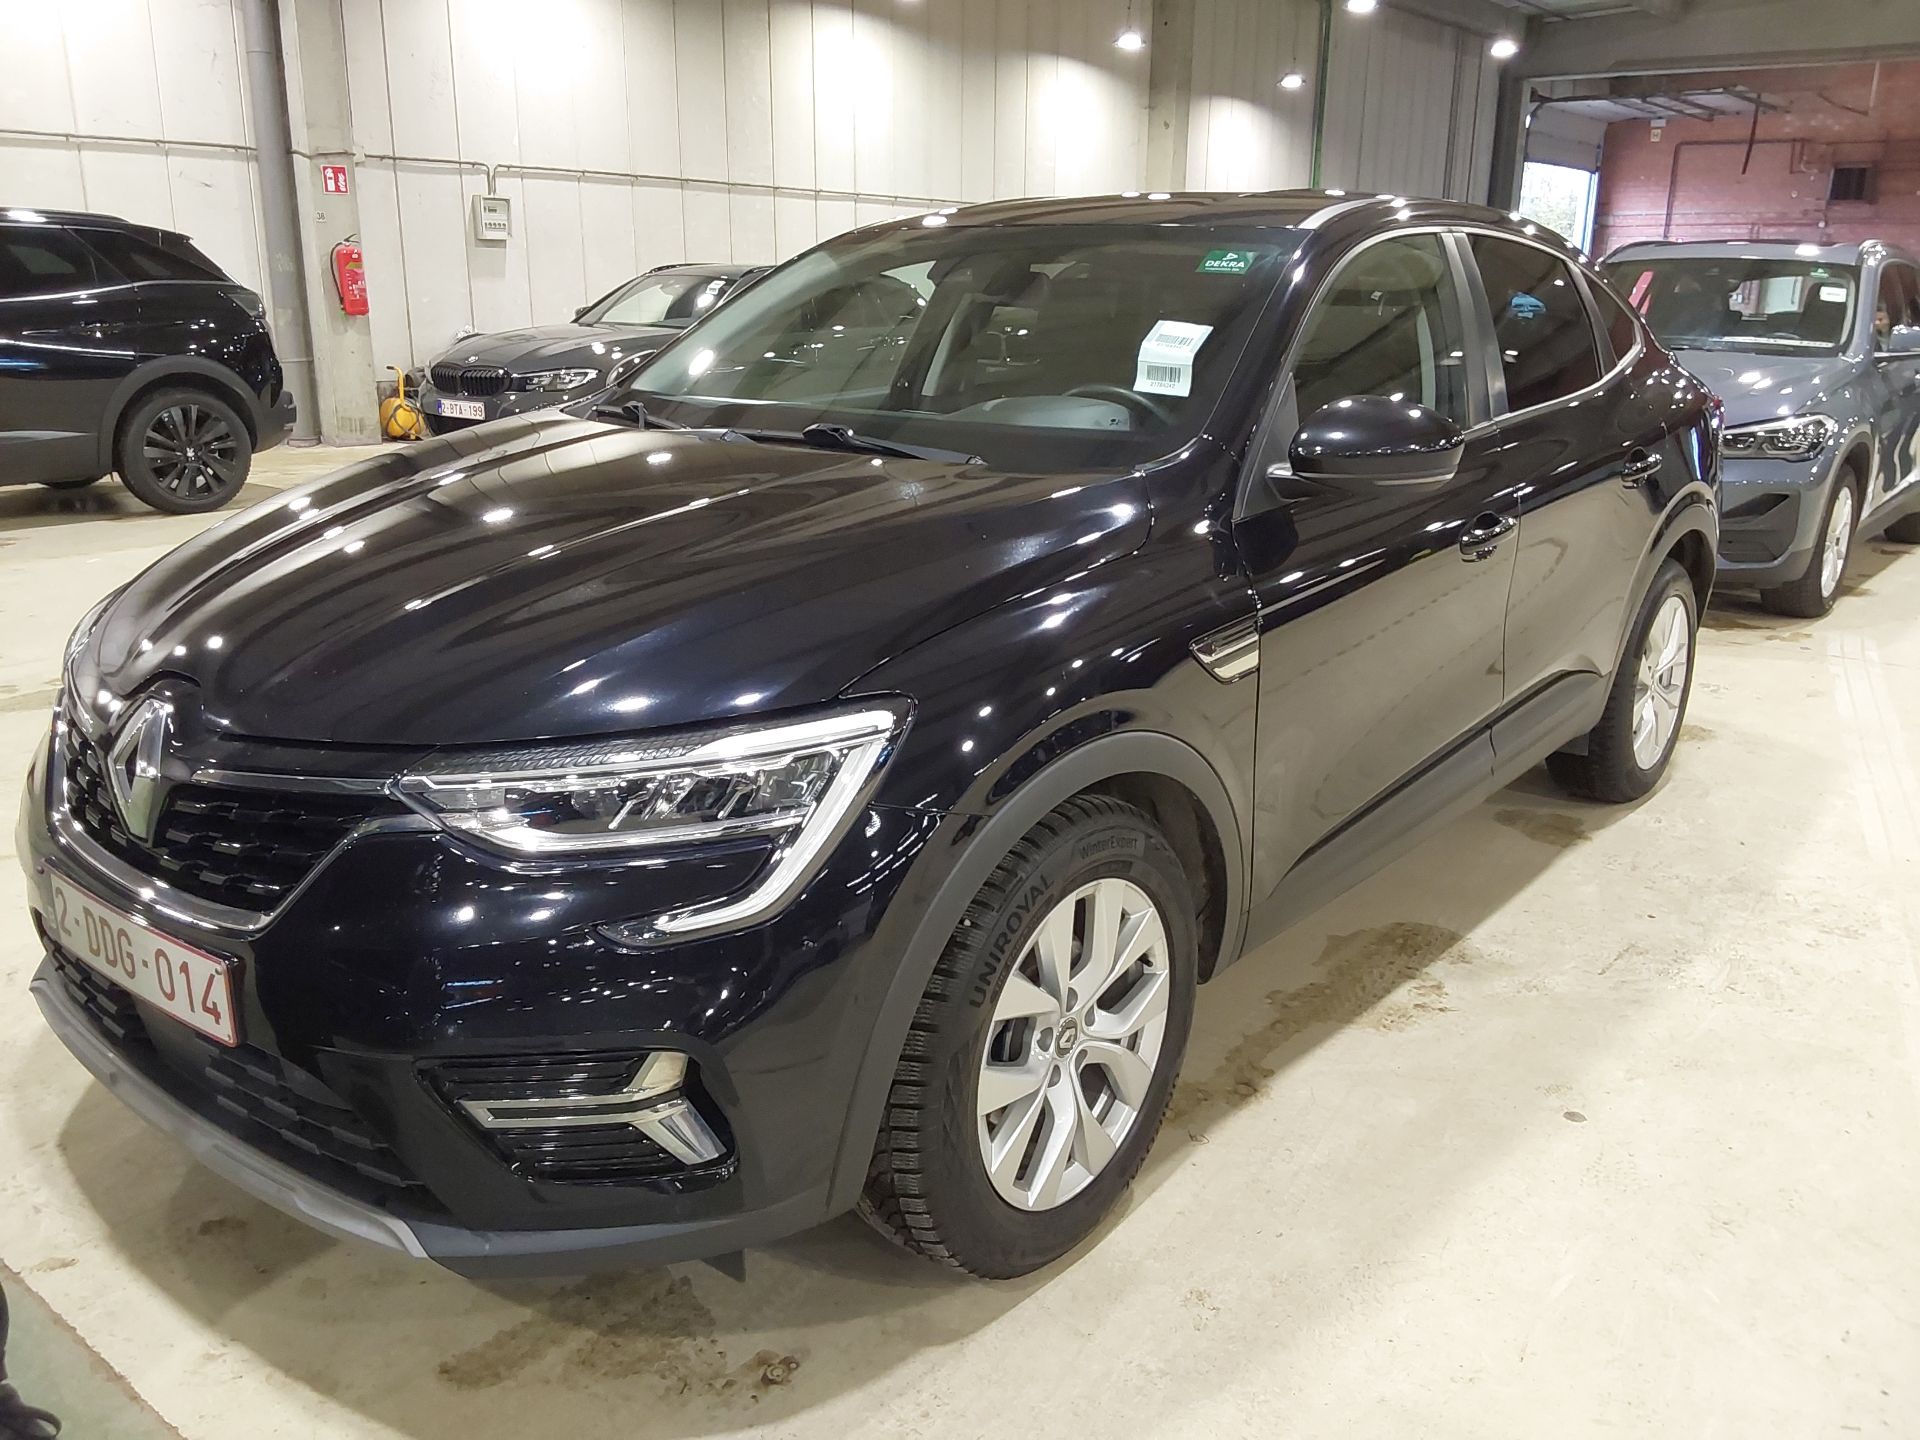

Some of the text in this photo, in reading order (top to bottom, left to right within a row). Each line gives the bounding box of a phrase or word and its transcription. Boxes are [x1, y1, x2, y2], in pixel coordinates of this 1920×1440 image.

[1205, 260, 1245, 268] DEKRA
[442, 402, 483, 417] 2-BTA-199
[1081, 835, 1137, 859] WinterExpert
[969, 874, 1055, 1009] UNIROYAL
[55, 886, 222, 1026] 2-DDG-014
